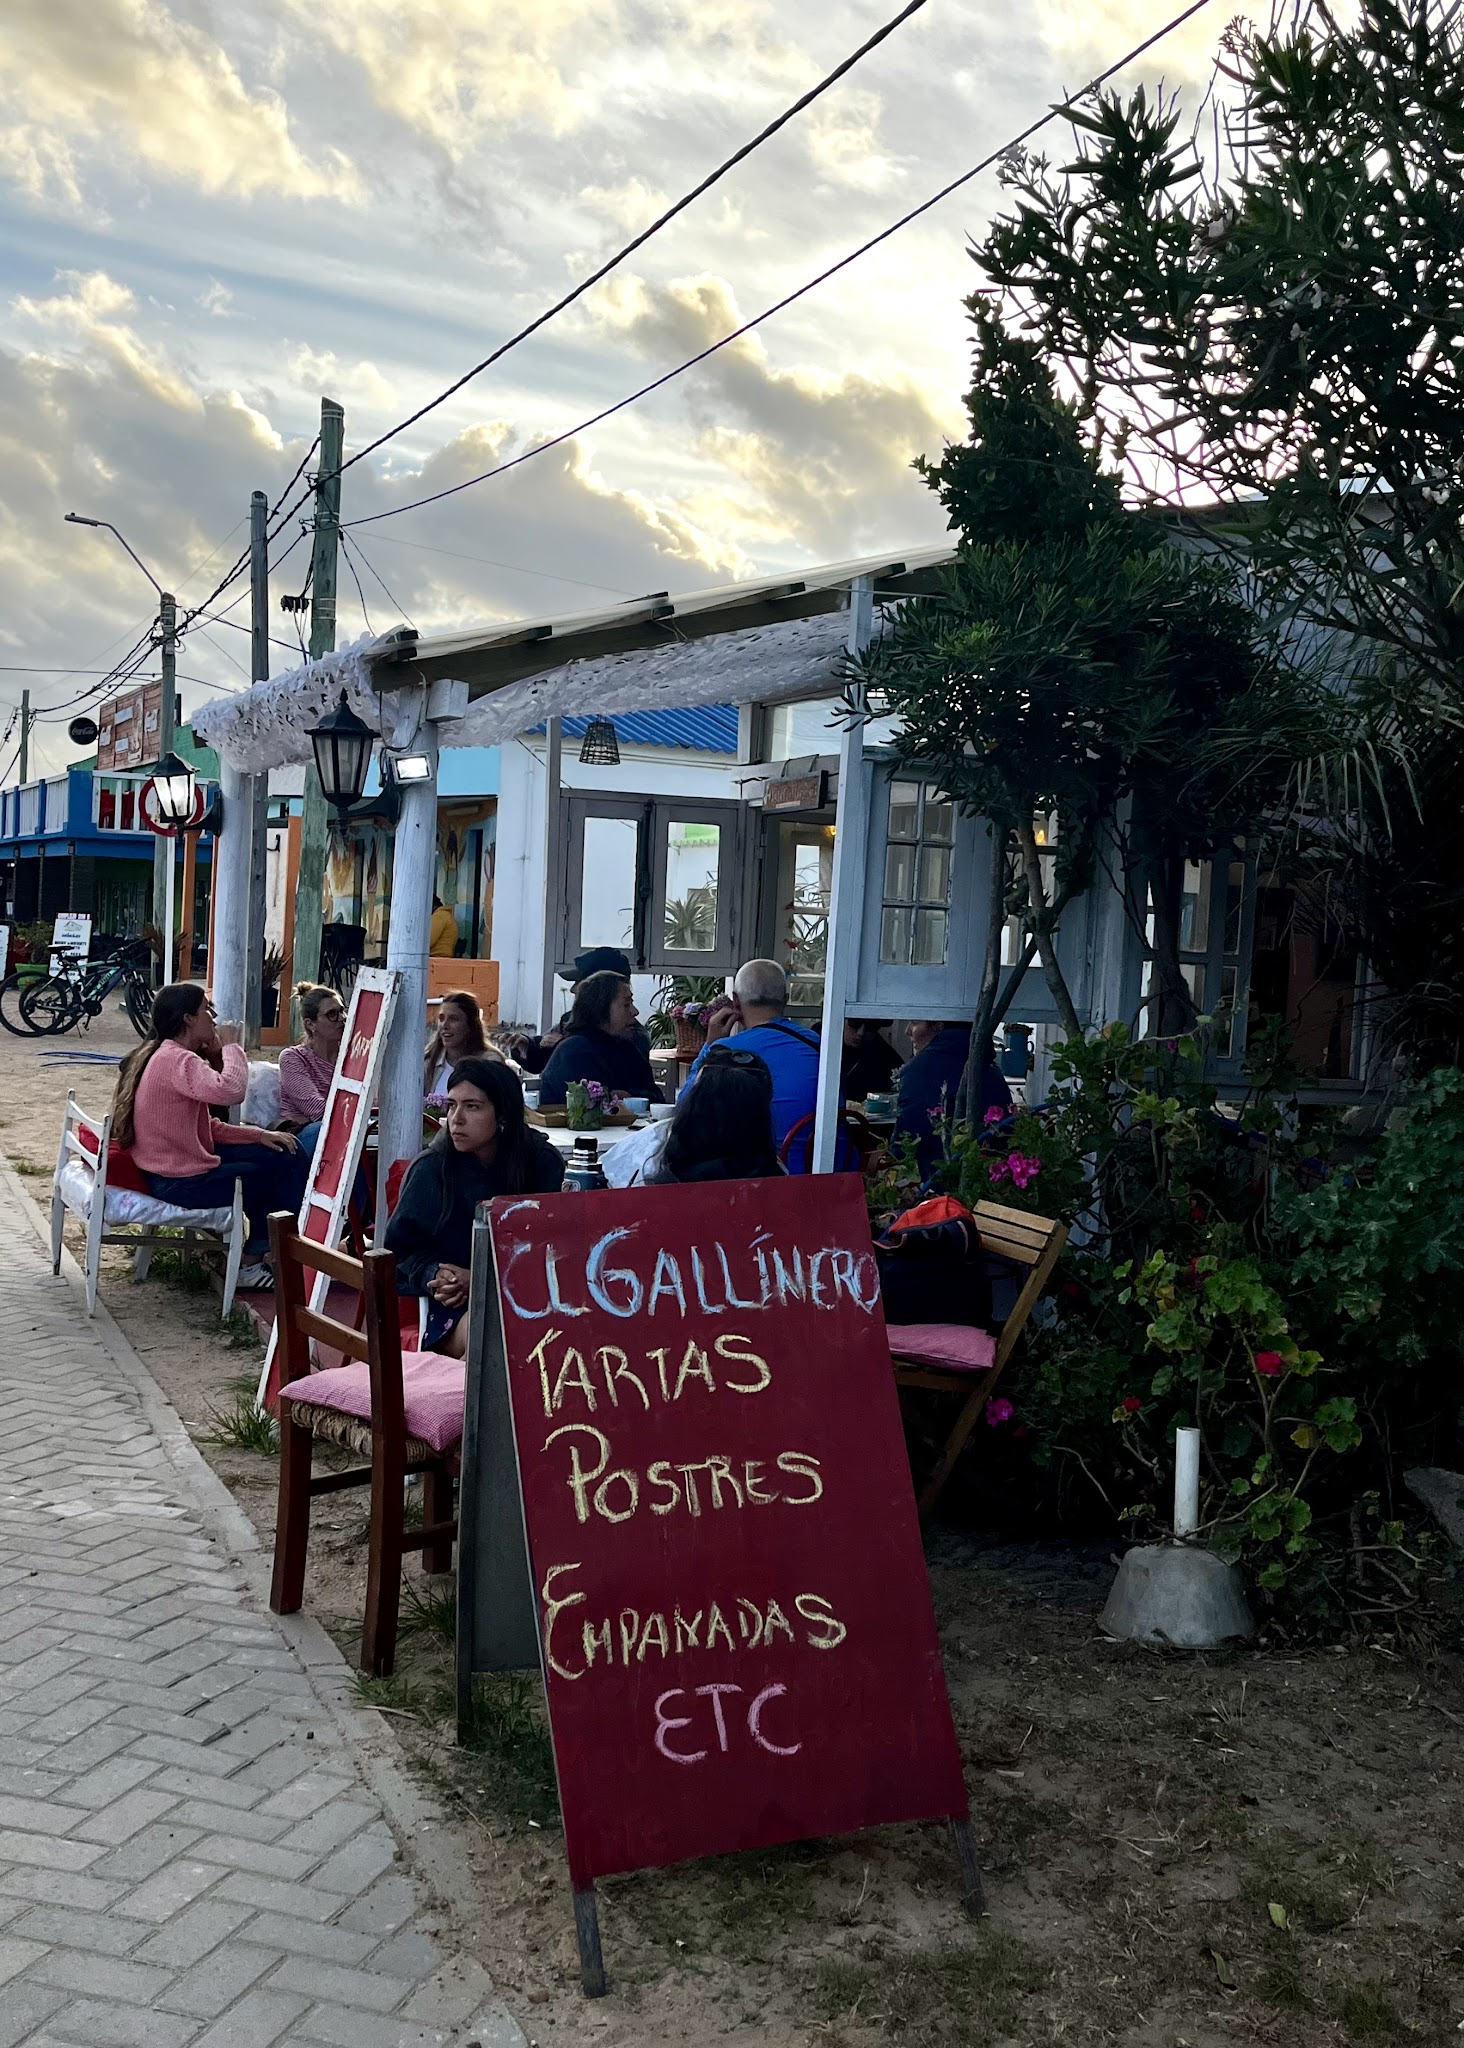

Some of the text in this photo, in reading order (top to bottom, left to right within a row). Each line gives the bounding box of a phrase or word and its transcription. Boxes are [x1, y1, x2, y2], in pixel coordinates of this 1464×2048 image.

[526, 1327, 772, 1418] TARTAS
[540, 1424, 823, 1523] POSTRES
[541, 1562, 847, 1680] EMPANADAS
[654, 1683, 802, 1764] ETC
